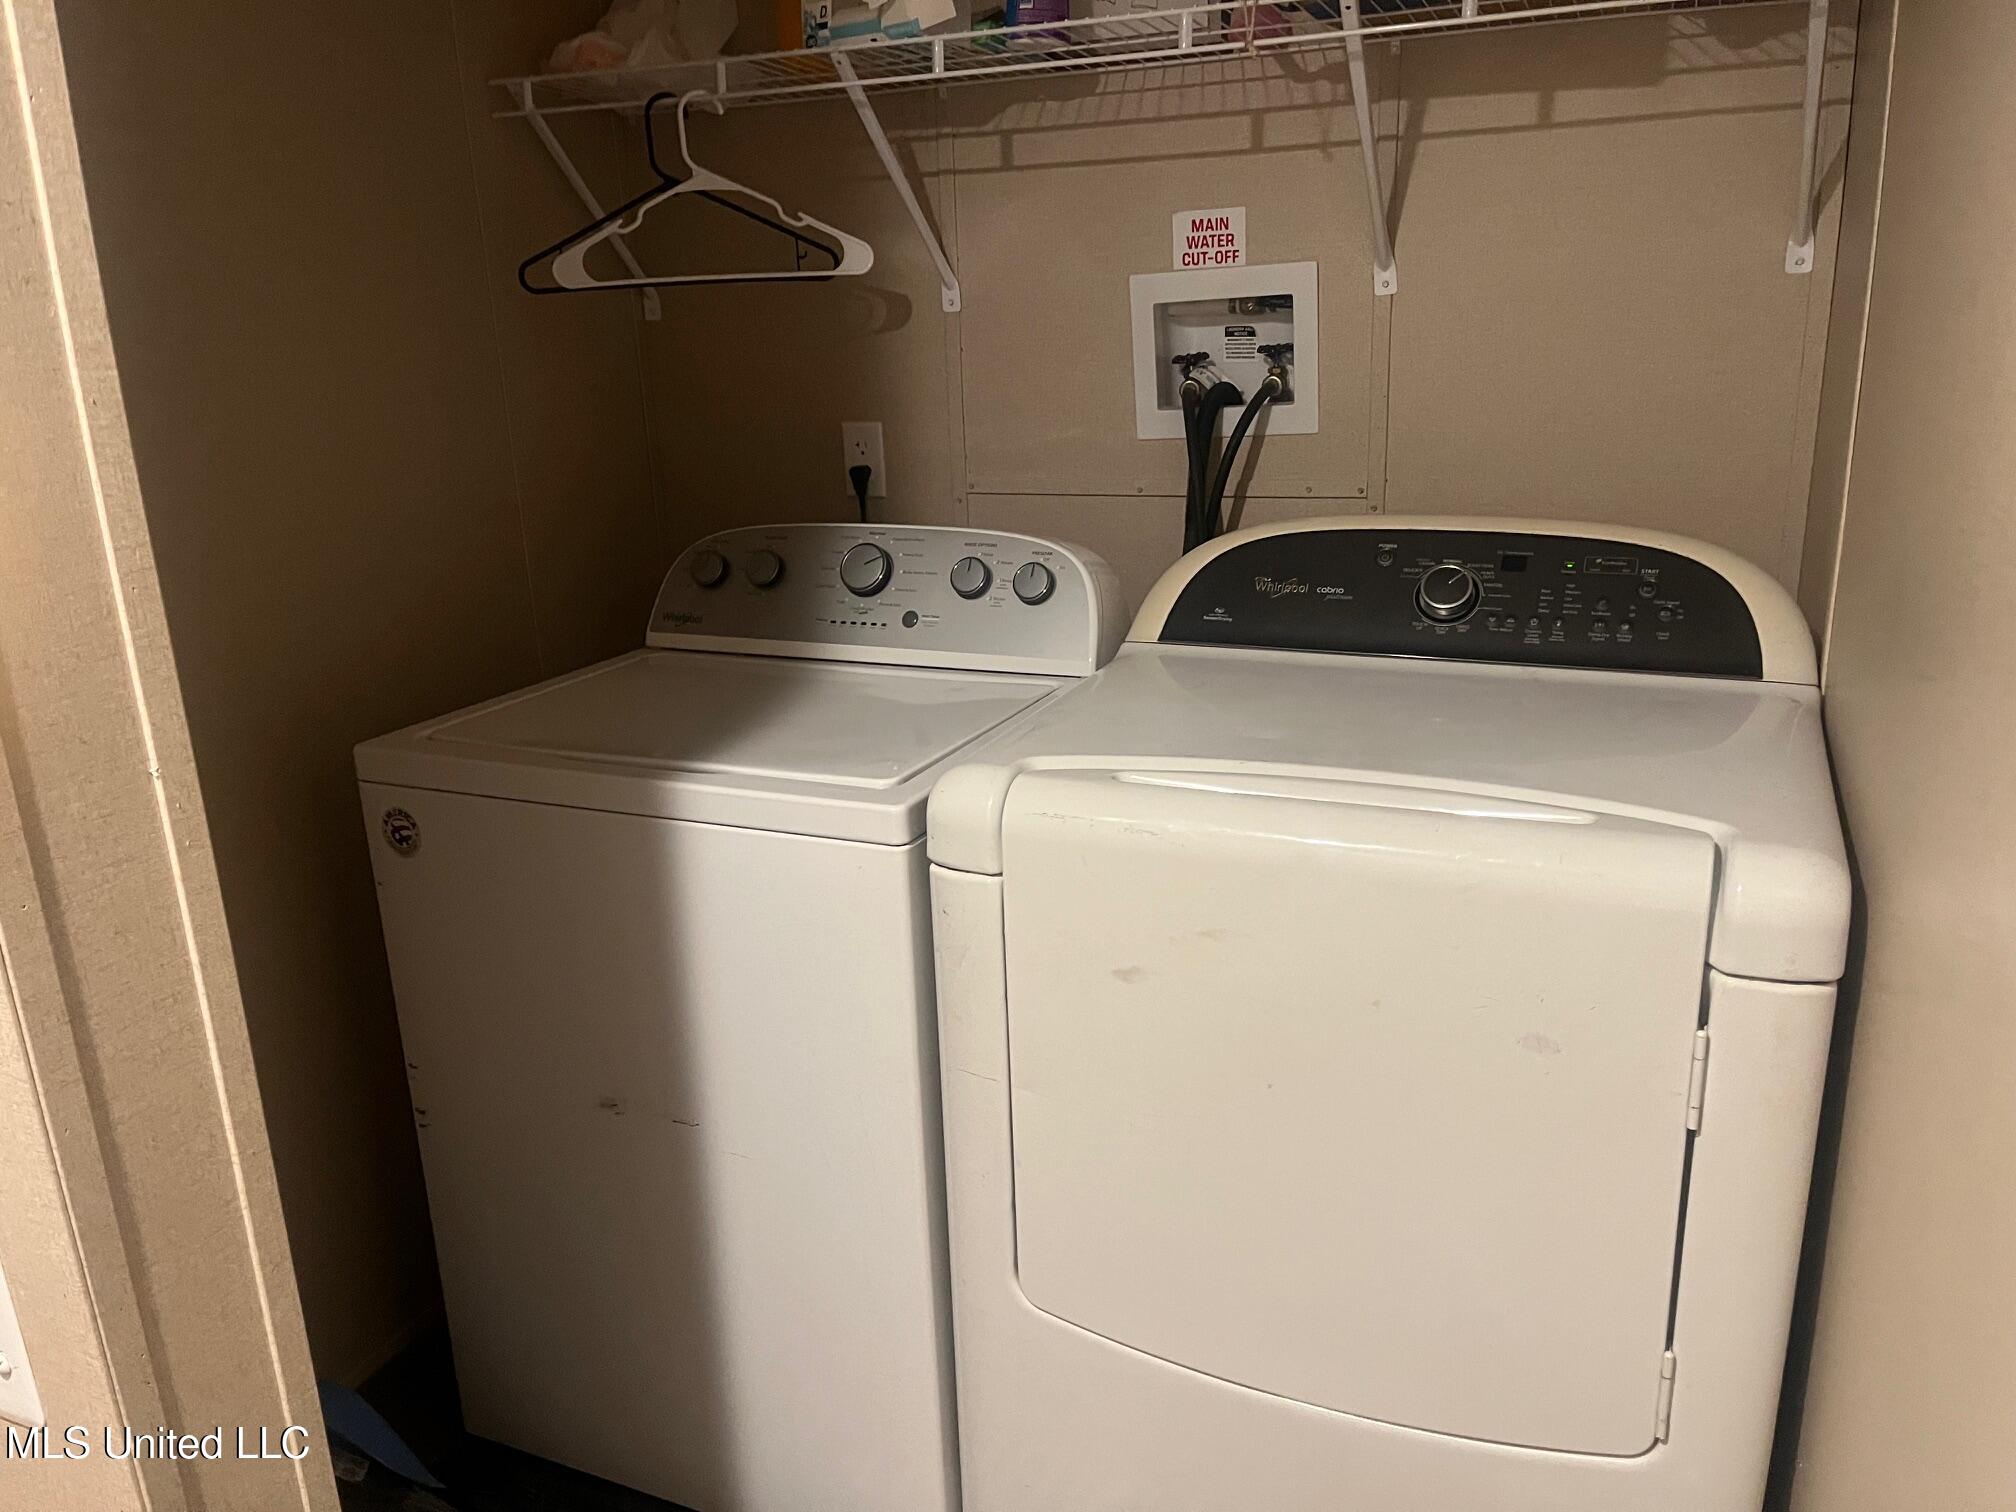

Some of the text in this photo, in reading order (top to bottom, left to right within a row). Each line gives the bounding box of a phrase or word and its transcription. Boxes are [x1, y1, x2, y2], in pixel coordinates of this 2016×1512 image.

[1191, 216, 1229, 233] MAIN
[1186, 233, 1235, 250] WATER
[1182, 249, 1240, 267] CUT-OFF
[1254, 578, 1345, 596] Whirlpool cabrio
